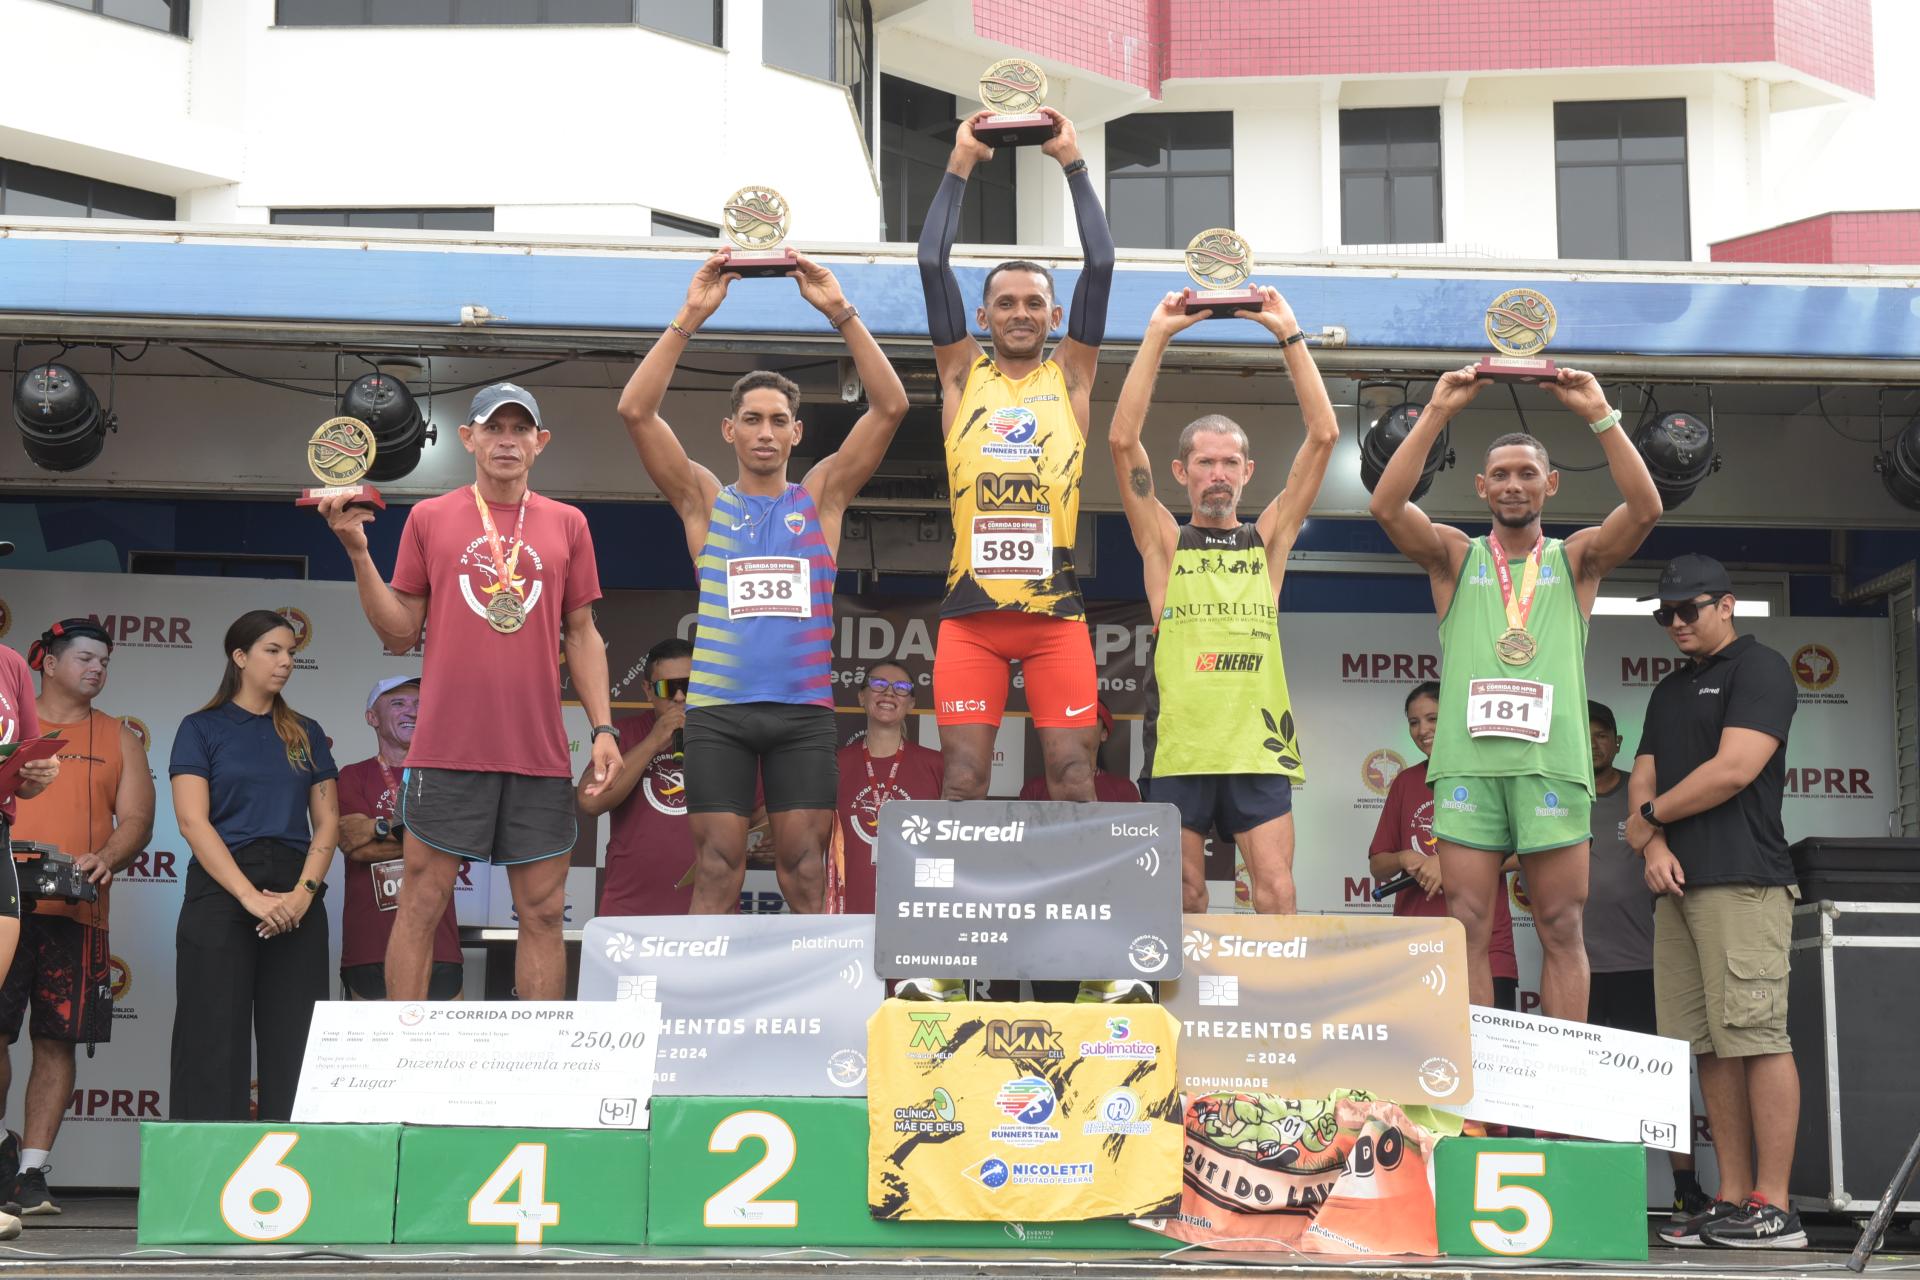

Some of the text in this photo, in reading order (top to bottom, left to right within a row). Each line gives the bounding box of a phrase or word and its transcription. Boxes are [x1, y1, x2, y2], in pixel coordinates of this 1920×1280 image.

[982, 446, 1018, 455] RUNNERS
[524, 544, 543, 571] MPRR
[982, 539, 1035, 561] 589
[740, 579, 793, 601] 338
[1176, 602, 1277, 619] NUTRILITE
[89, 614, 193, 644] MPRR
[1216, 653, 1264, 672] ENERGY
[1342, 653, 1440, 679] MPRR
[941, 699, 987, 713] INEOS
[1479, 700, 1530, 722] 181
[1784, 767, 1874, 794] MPRR
[935, 819, 1160, 843] Sicredi black
[898, 901, 1112, 921] SETECENTOS REAIS
[638, 935, 864, 958] Sicredi platinum
[970, 931, 1009, 943] 2024
[1217, 935, 1444, 959] Sicredi gold
[895, 954, 978, 966] COMUNIDADE
[429, 1010, 574, 1021] 2ª CORRIDA DO MPRR
[658, 1017, 821, 1035] HENTOS REAIS
[1183, 1021, 1389, 1041] TREZENTOS REAIS
[1472, 1013, 1603, 1043] CORRIDA DO MPRR
[570, 1031, 645, 1051] 250,00
[1081, 1041, 1155, 1055] Sublimatize
[670, 1047, 708, 1059] 2024
[1048, 1049, 1064, 1058] CELL
[1258, 1052, 1297, 1065] 2024
[396, 1057, 601, 1074] Duzentos e cinquenta reais
[1472, 1059, 1494, 1072] tos
[1498, 1065, 1537, 1079] reais
[1599, 1050, 1674, 1077] 200,00
[348, 1076, 397, 1091] Lugar
[1185, 1076, 1269, 1089] COMUNIDADE
[64, 1088, 162, 1117] MPRR
[895, 1106, 937, 1120] CLÍNICA
[895, 1120, 964, 1132] MÃE DE DEUS
[991, 1131, 1059, 1139] RUNNERS TEAM
[1283, 1117, 1301, 1136] 01
[1355, 1126, 1405, 1178] DO
[703, 1111, 799, 1228] 2
[1013, 1163, 1094, 1176] NICOLETTI
[1013, 1175, 1094, 1184] DEPUTADO FEDERAL
[220, 1131, 312, 1241] 6
[467, 1142, 560, 1245] 4
[1469, 1151, 1554, 1256] 5
[1753, 1215, 1785, 1239] FILA
